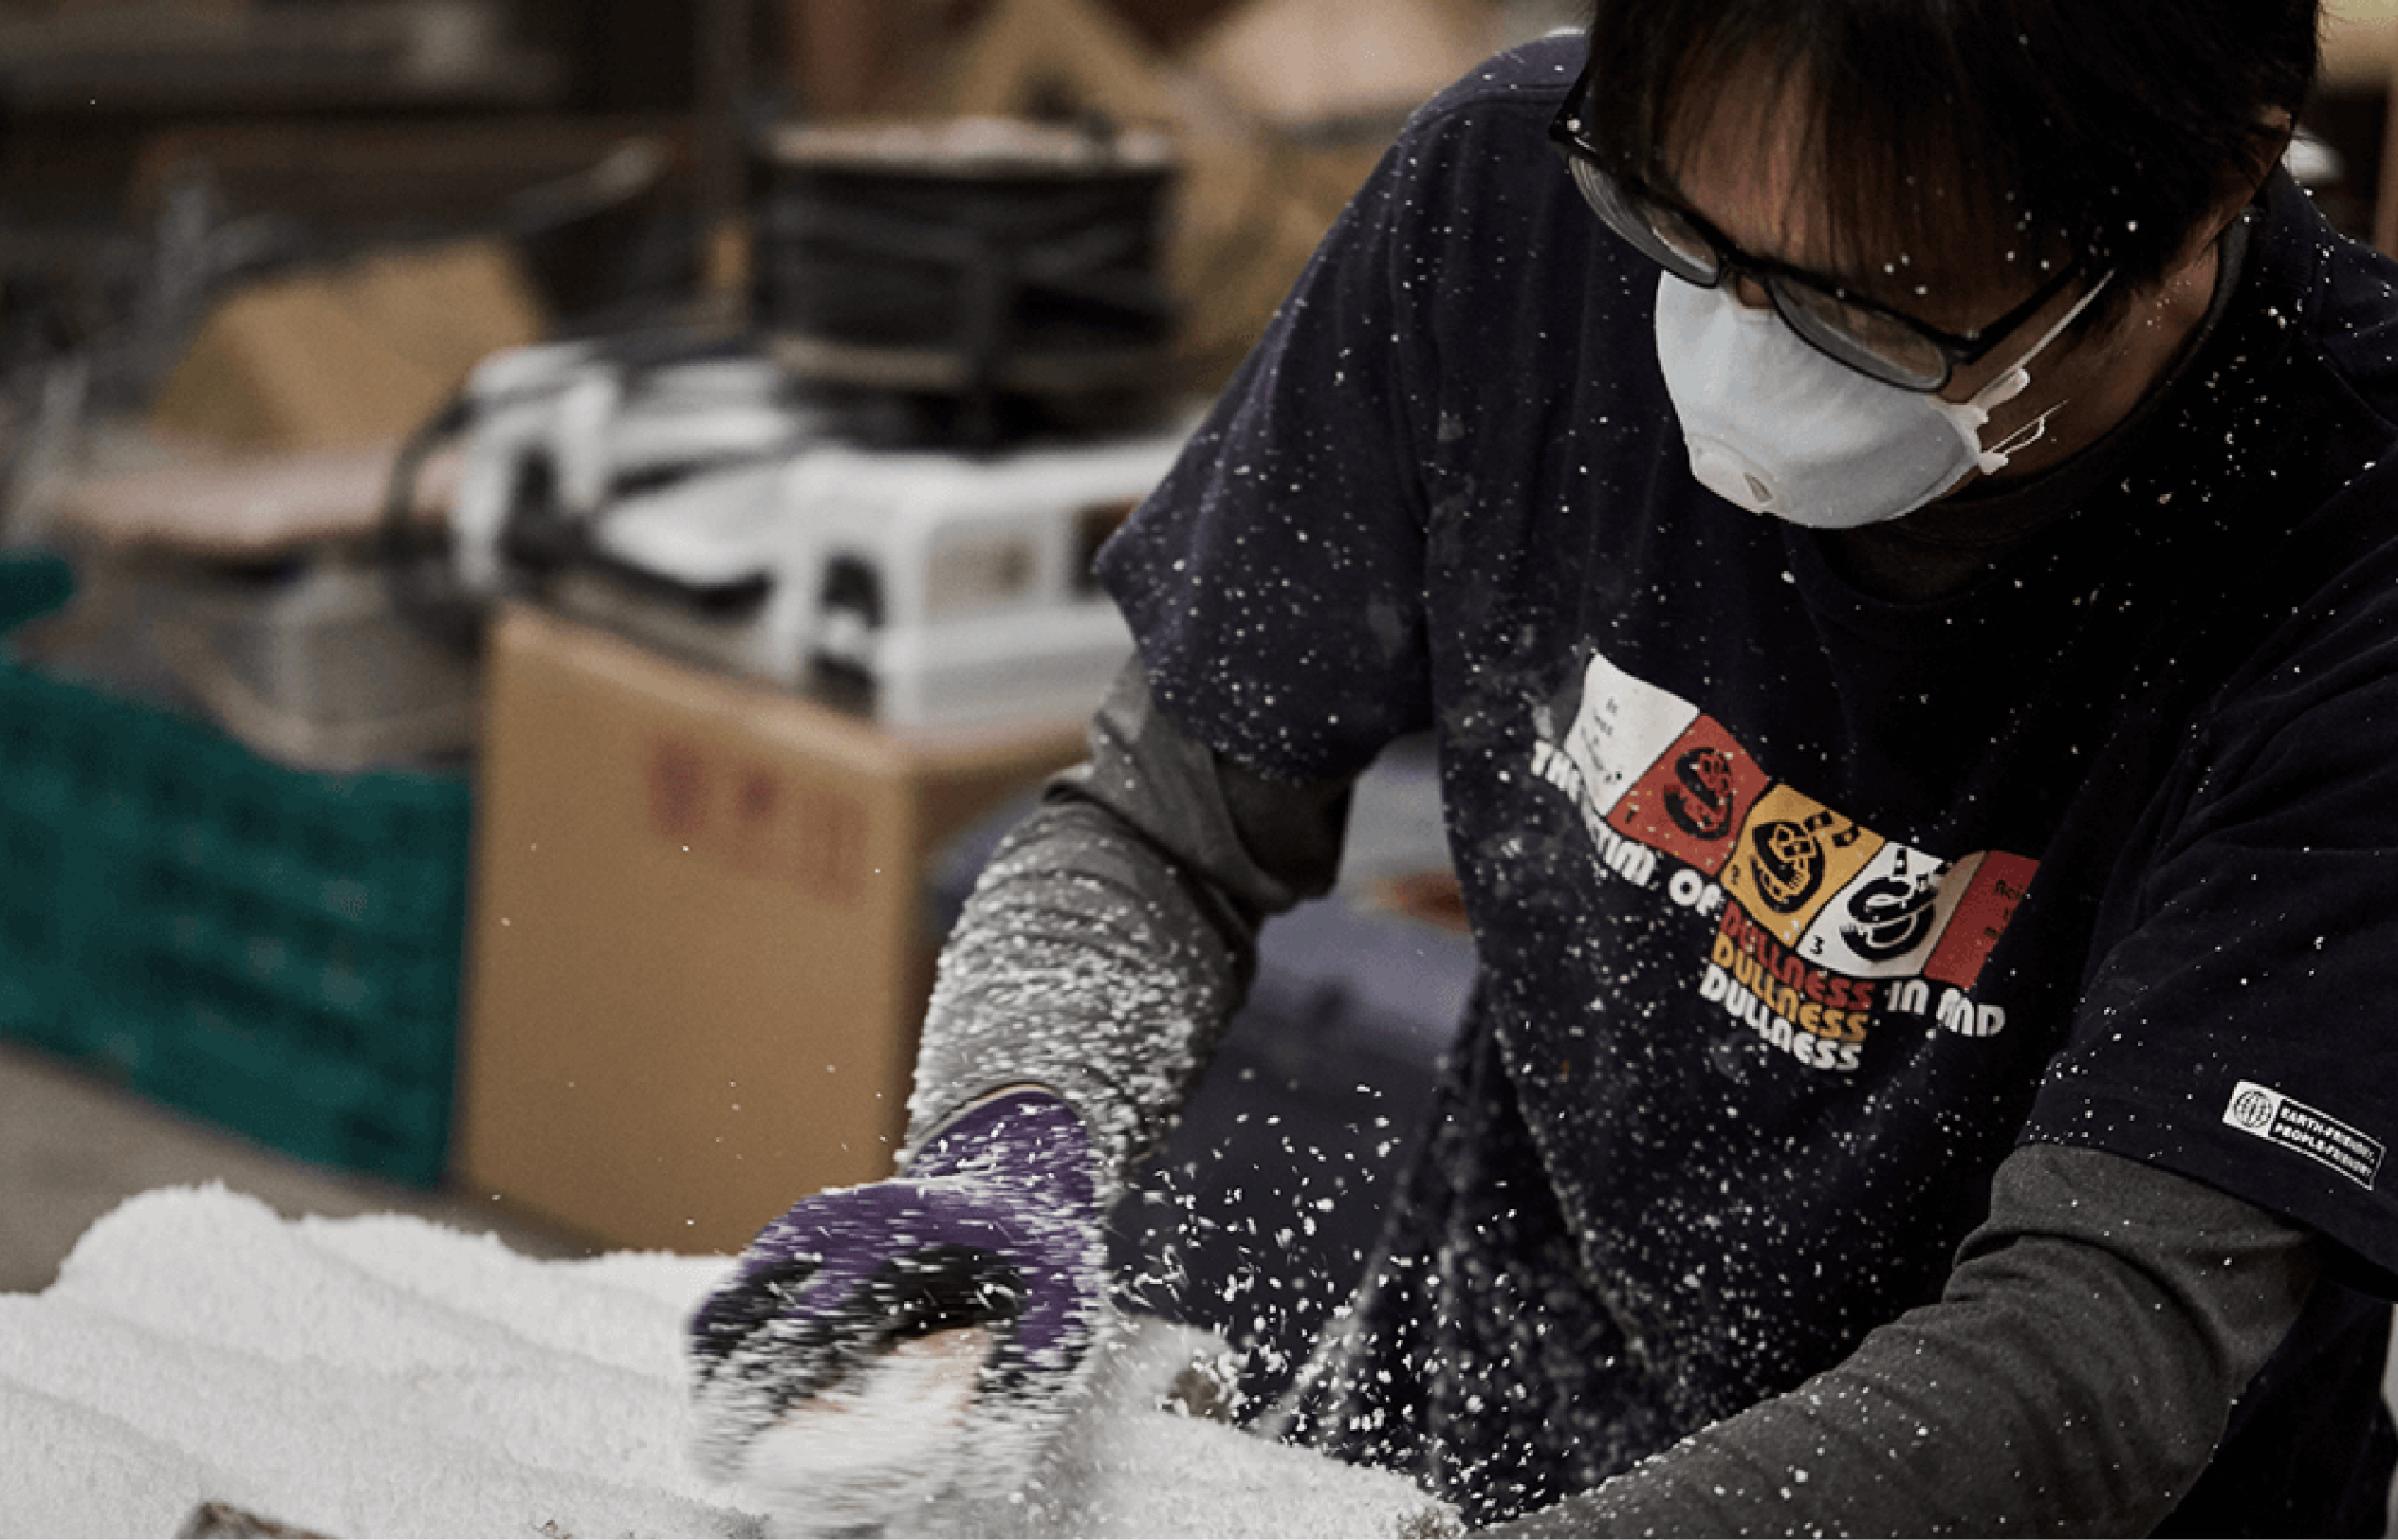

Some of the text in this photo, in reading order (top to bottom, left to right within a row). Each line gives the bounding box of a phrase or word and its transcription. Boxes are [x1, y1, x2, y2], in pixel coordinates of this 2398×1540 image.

[1669, 869, 1723, 916] OF
[1720, 900, 1876, 1011] DULLNESS
[1887, 979, 1929, 1016] IN
[1711, 930, 1870, 1042] DULLNESS
[1699, 962, 1863, 1071] DULLNESS
